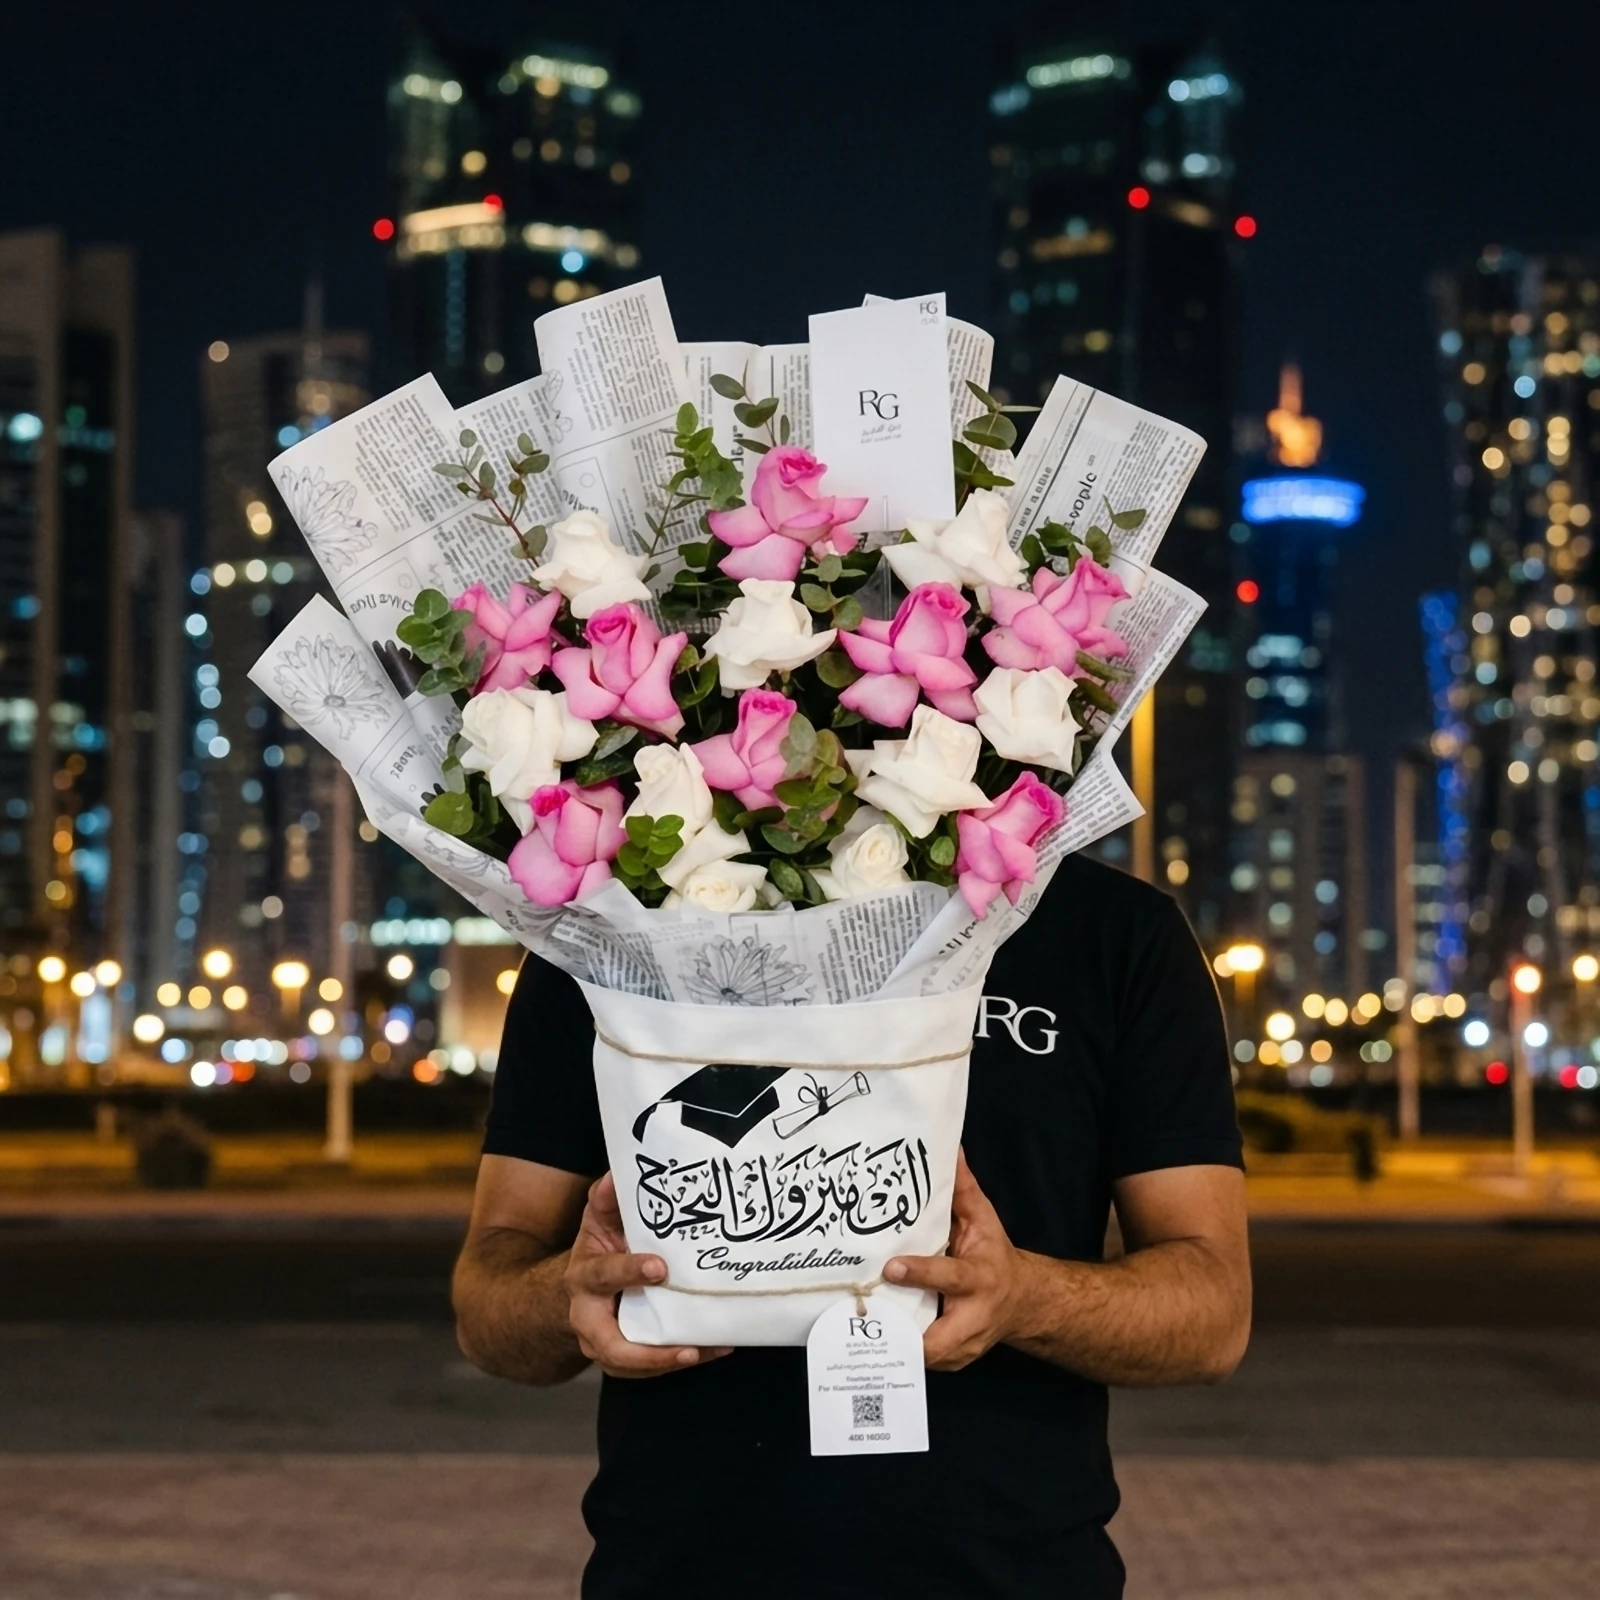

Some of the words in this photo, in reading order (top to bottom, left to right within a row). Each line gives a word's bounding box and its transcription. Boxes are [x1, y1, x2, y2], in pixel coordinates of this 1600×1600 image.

[858, 389, 900, 421] RG
[974, 995, 1061, 1056] RG
[848, 1316, 883, 1340] RG
